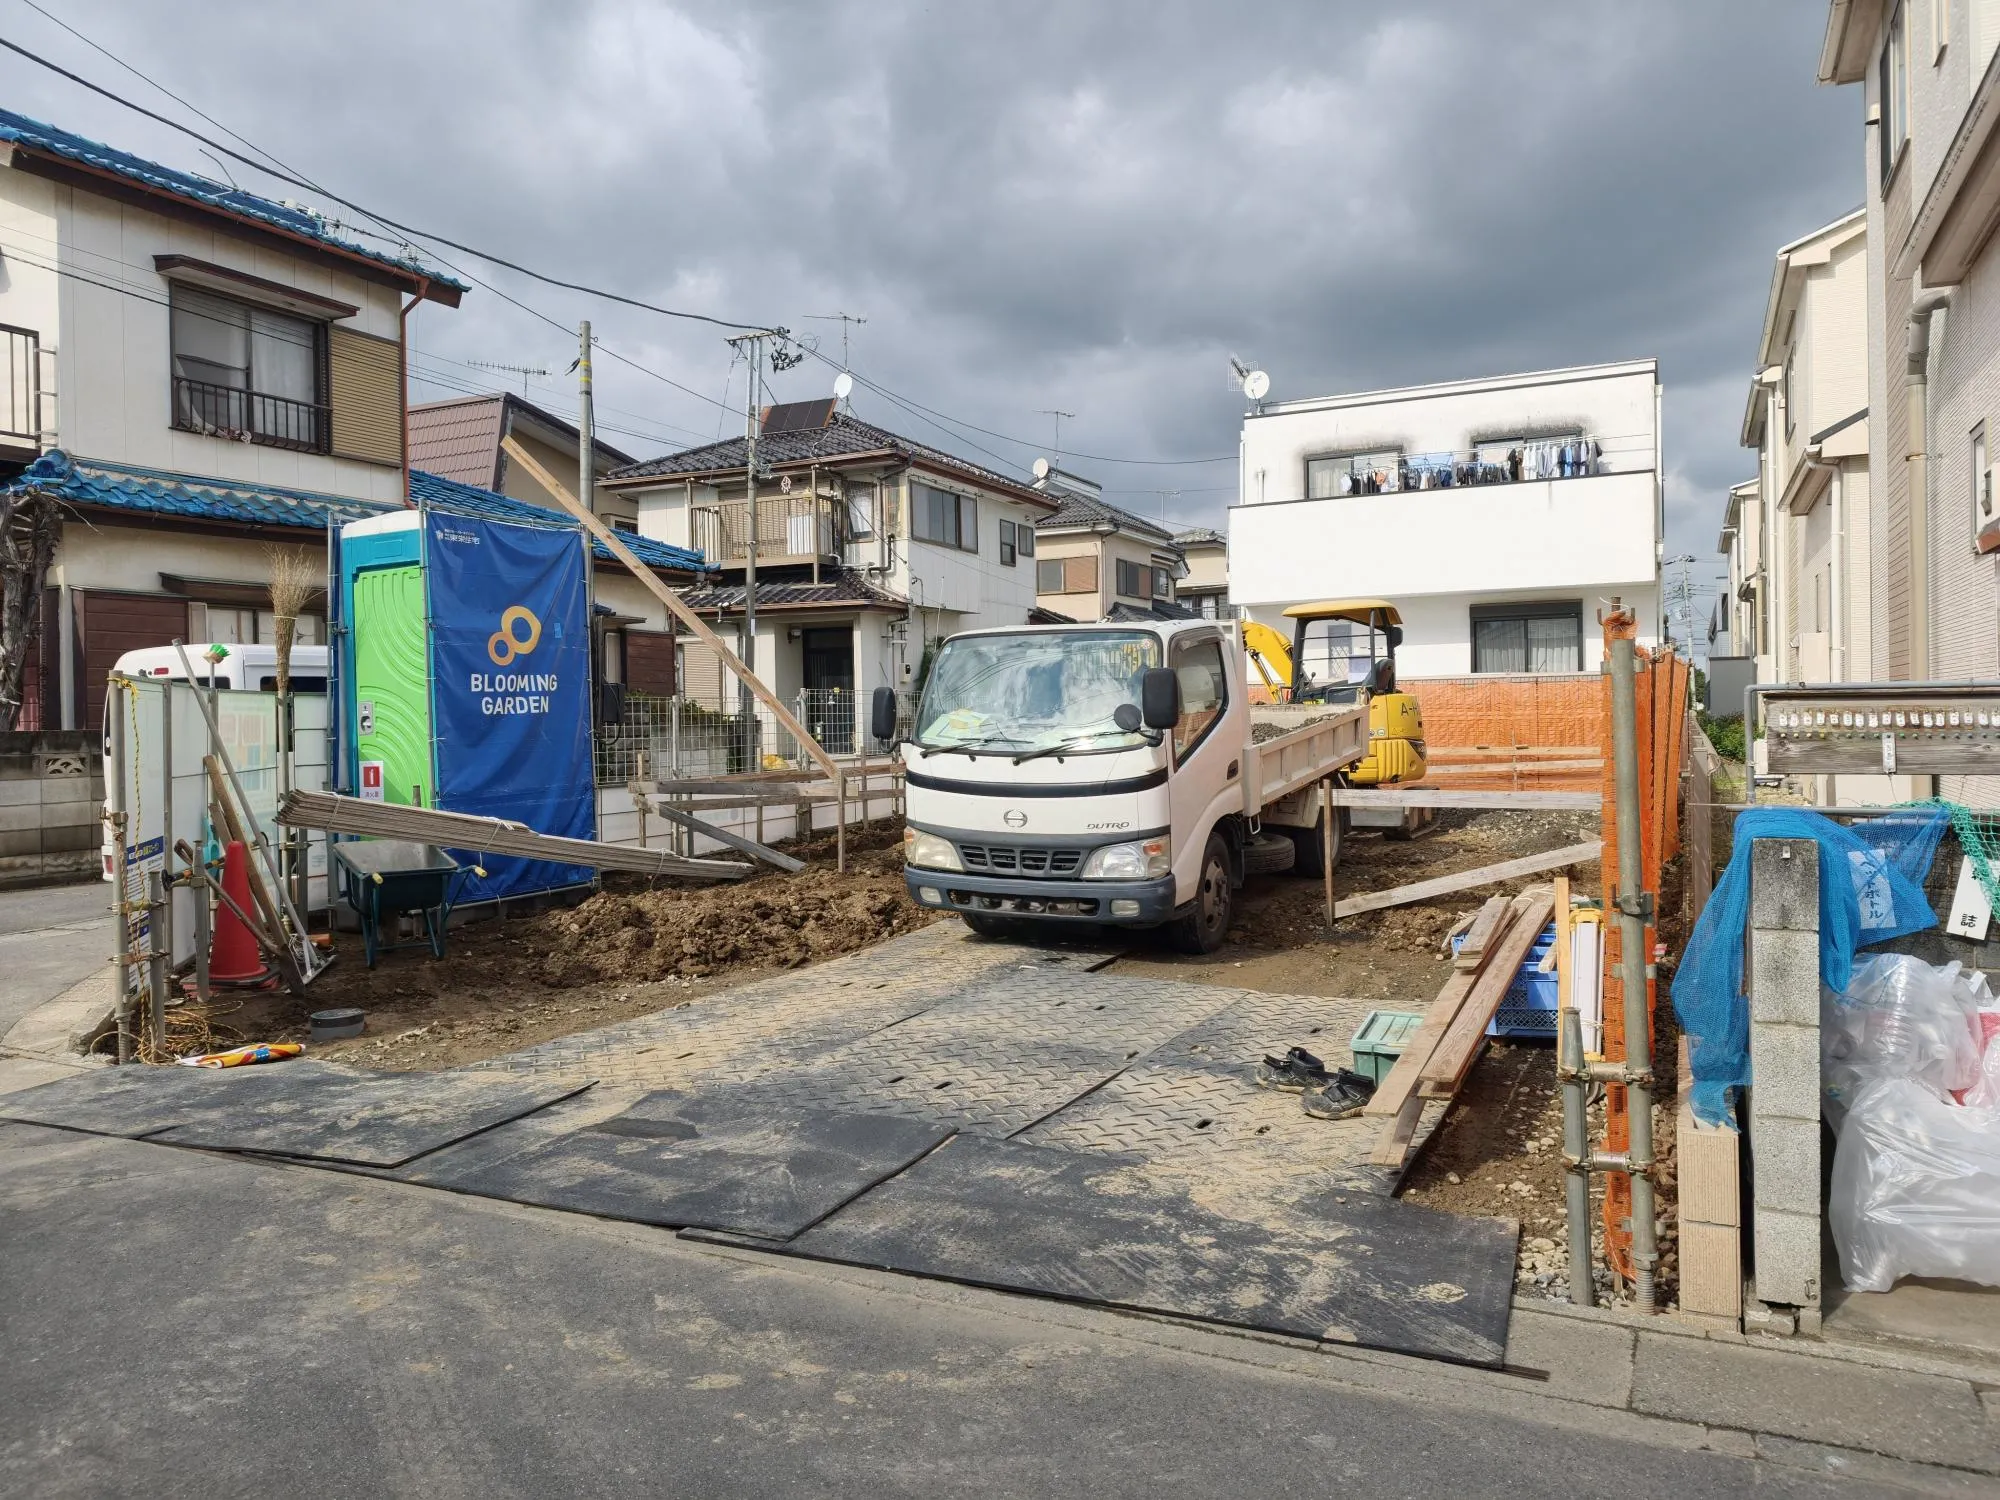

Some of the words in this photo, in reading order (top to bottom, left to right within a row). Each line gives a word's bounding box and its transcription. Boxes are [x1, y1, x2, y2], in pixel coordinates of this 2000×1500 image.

[470, 673, 558, 692] BLOOMING
[481, 696, 549, 715] GARDEN
[1087, 821, 1130, 830] DUTRO
